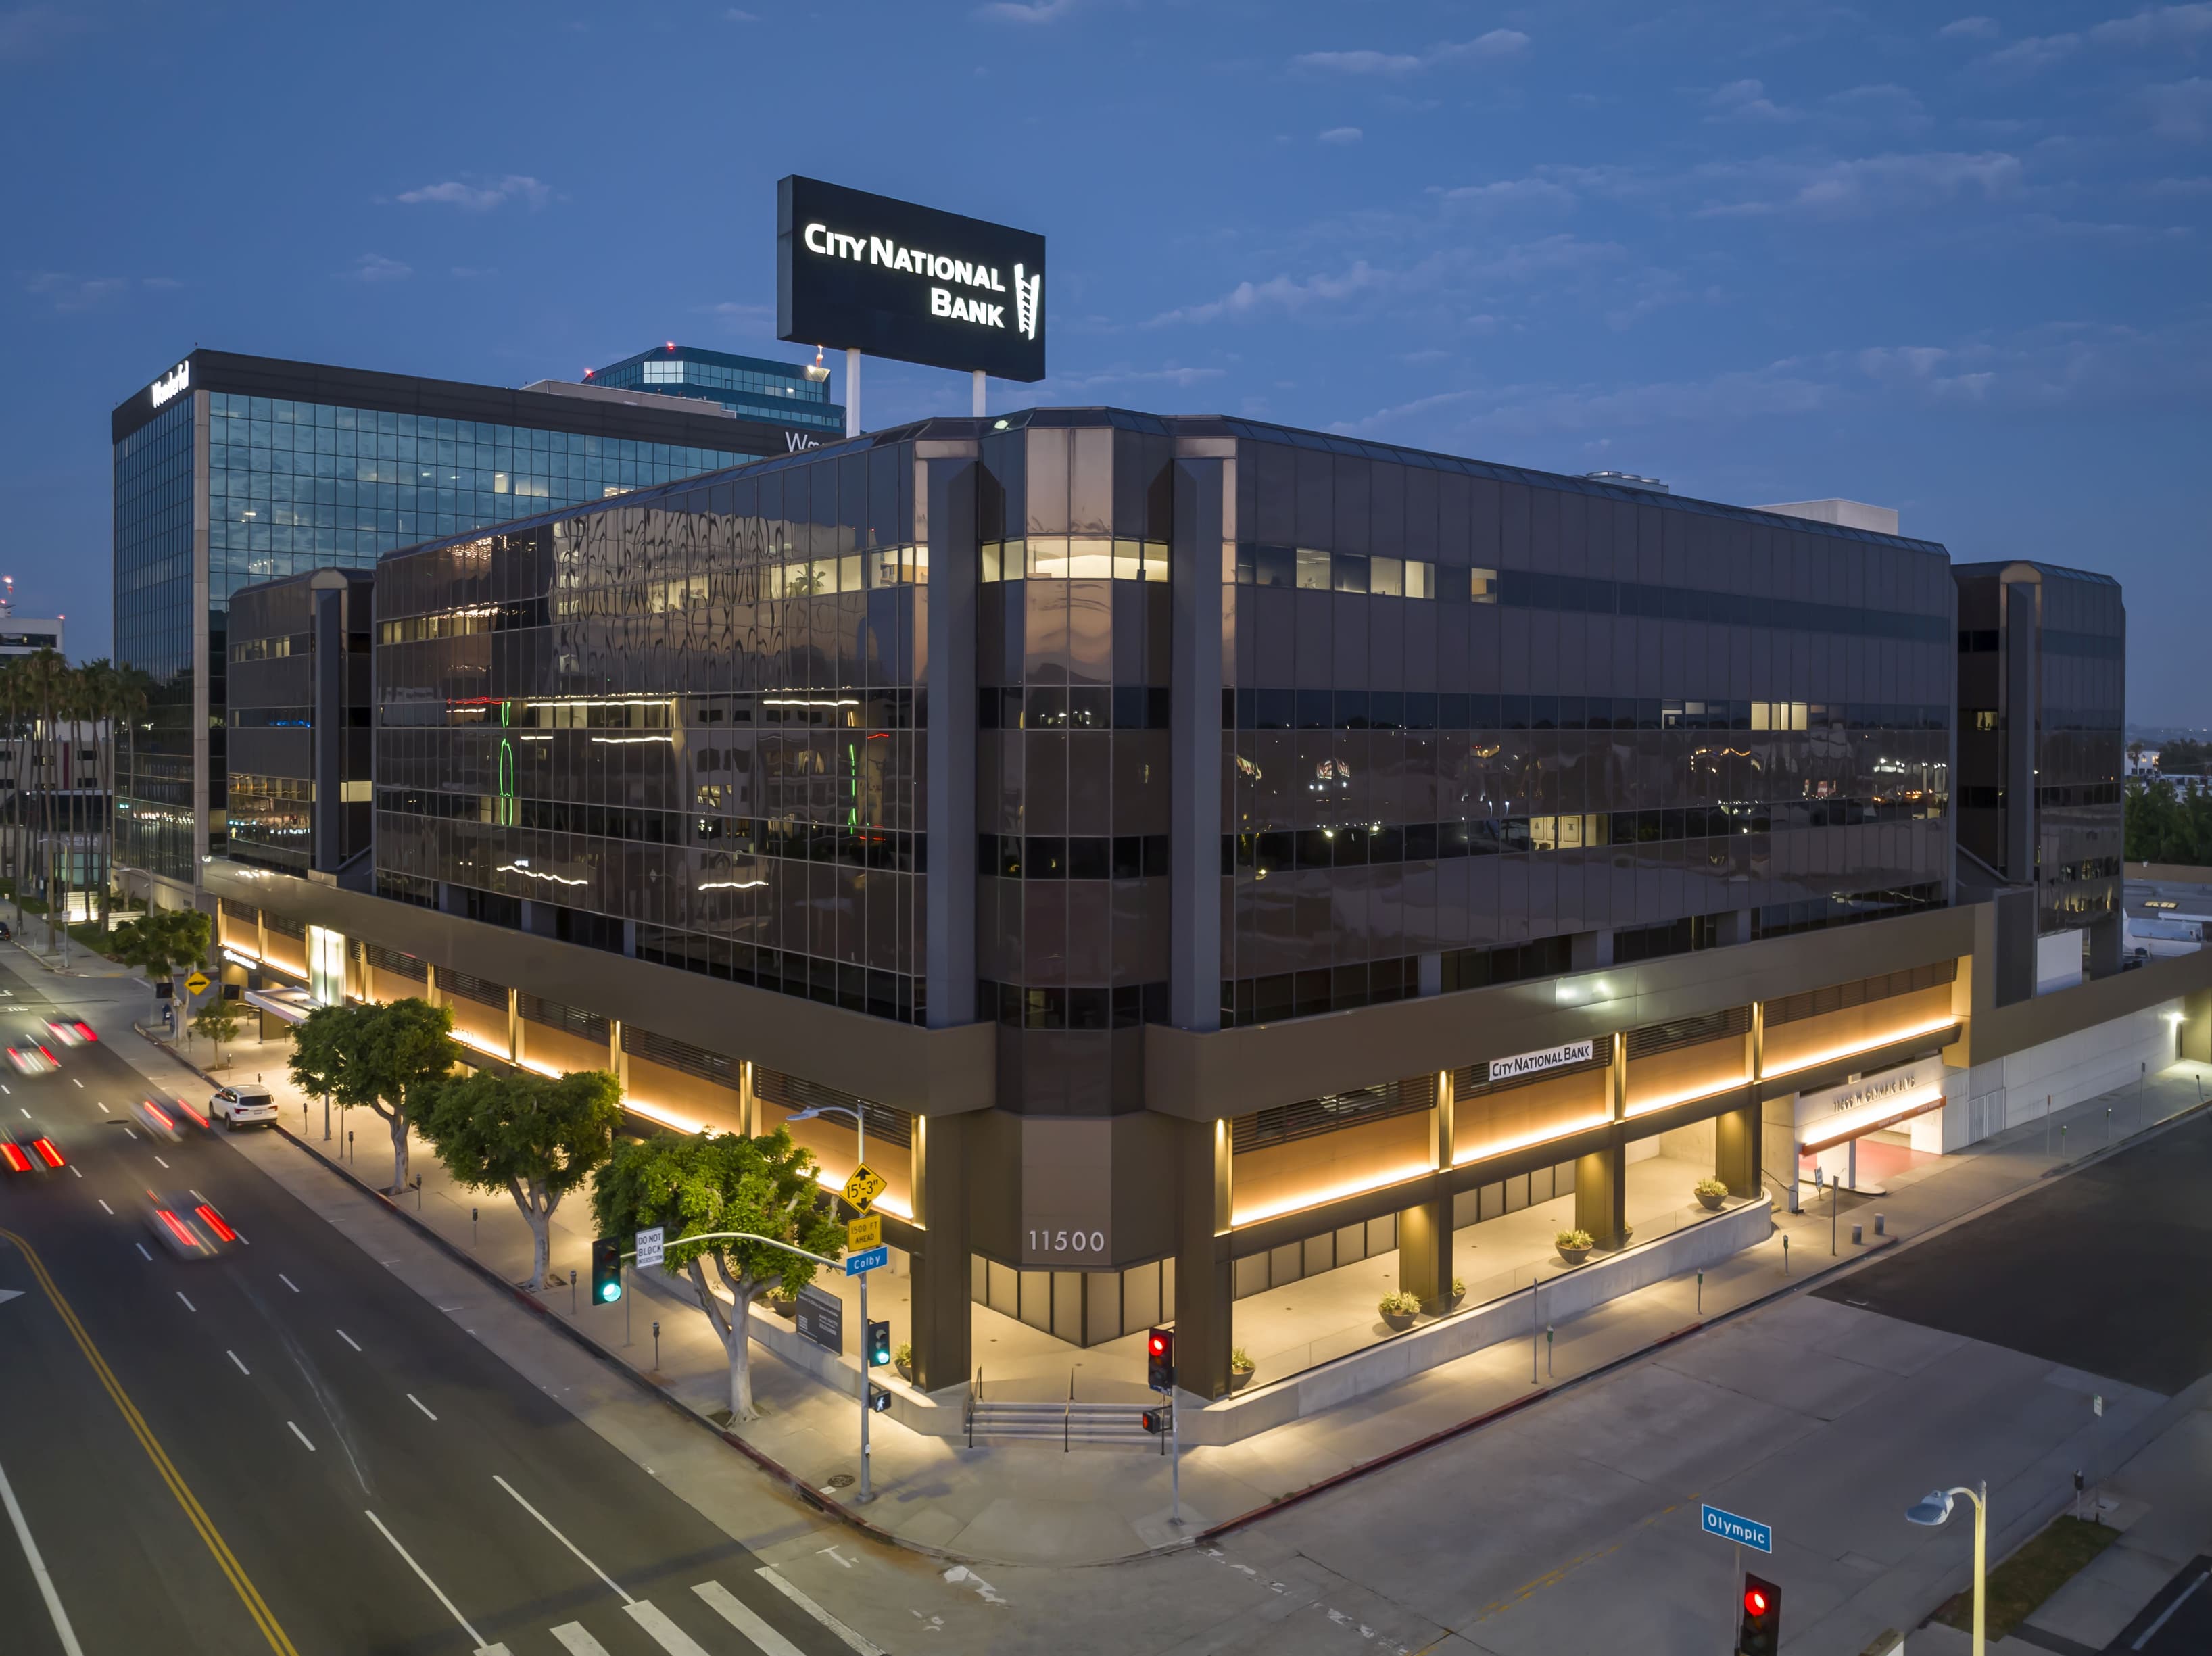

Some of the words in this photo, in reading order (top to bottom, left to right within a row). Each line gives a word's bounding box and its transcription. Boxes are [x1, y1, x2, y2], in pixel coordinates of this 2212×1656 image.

[804, 223, 867, 261] CITY
[870, 236, 1005, 292] NATIONAL
[931, 287, 1005, 328] BANK
[1492, 1062, 1513, 1077] CITY
[1514, 1052, 1562, 1072] NATIONAL
[1564, 1045, 1590, 1061] BANK
[851, 1223, 867, 1234] 1500
[870, 1221, 877, 1230] FT
[638, 1236, 648, 1245] DO
[649, 1232, 661, 1243] NOT
[855, 1233, 875, 1244] AHEAD
[1030, 1230, 1105, 1252] 11500
[638, 1244, 661, 1257] BLOCK
[854, 1255, 881, 1270] Colby
[1708, 1513, 1765, 1544] Olympic
